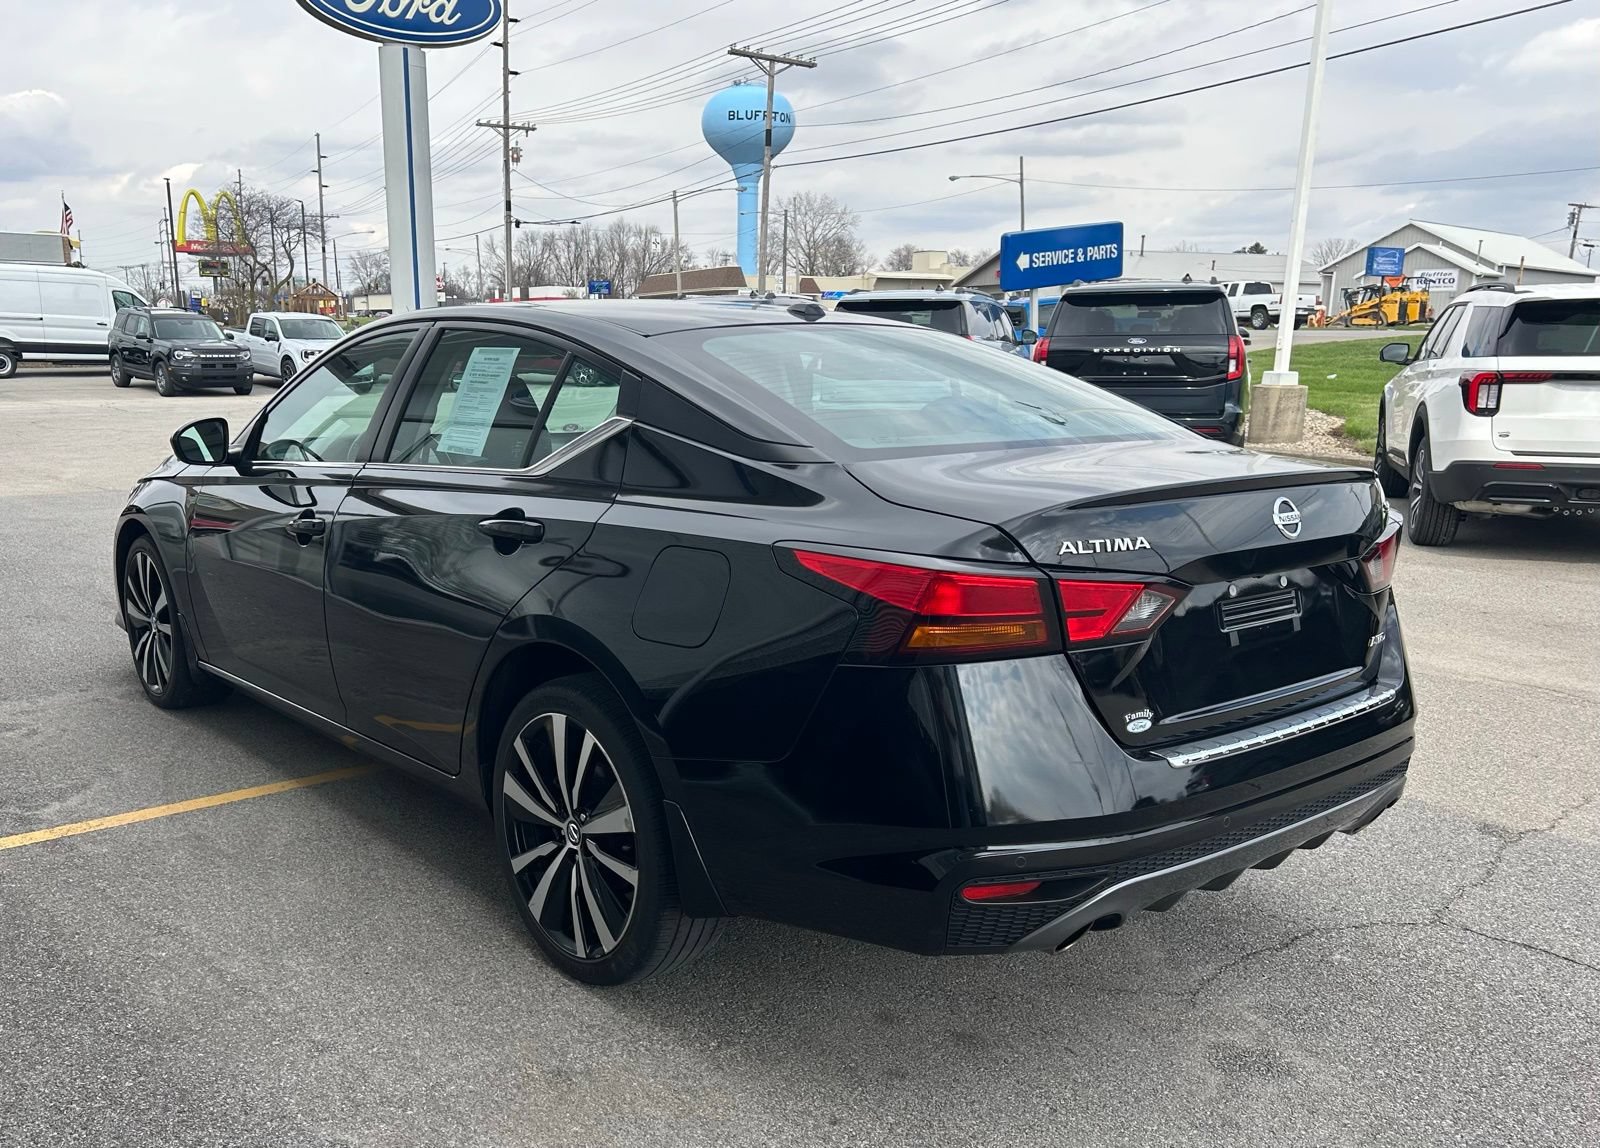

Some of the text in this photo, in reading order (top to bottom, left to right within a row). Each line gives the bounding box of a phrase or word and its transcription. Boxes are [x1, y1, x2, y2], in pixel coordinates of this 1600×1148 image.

[728, 110, 791, 124] BLUFFTON
[1032, 244, 1118, 268] SERVICE & PARTS
[1058, 536, 1151, 555] ALTIMA
[1124, 709, 1154, 723] Family
[1131, 721, 1147, 731] Ford
